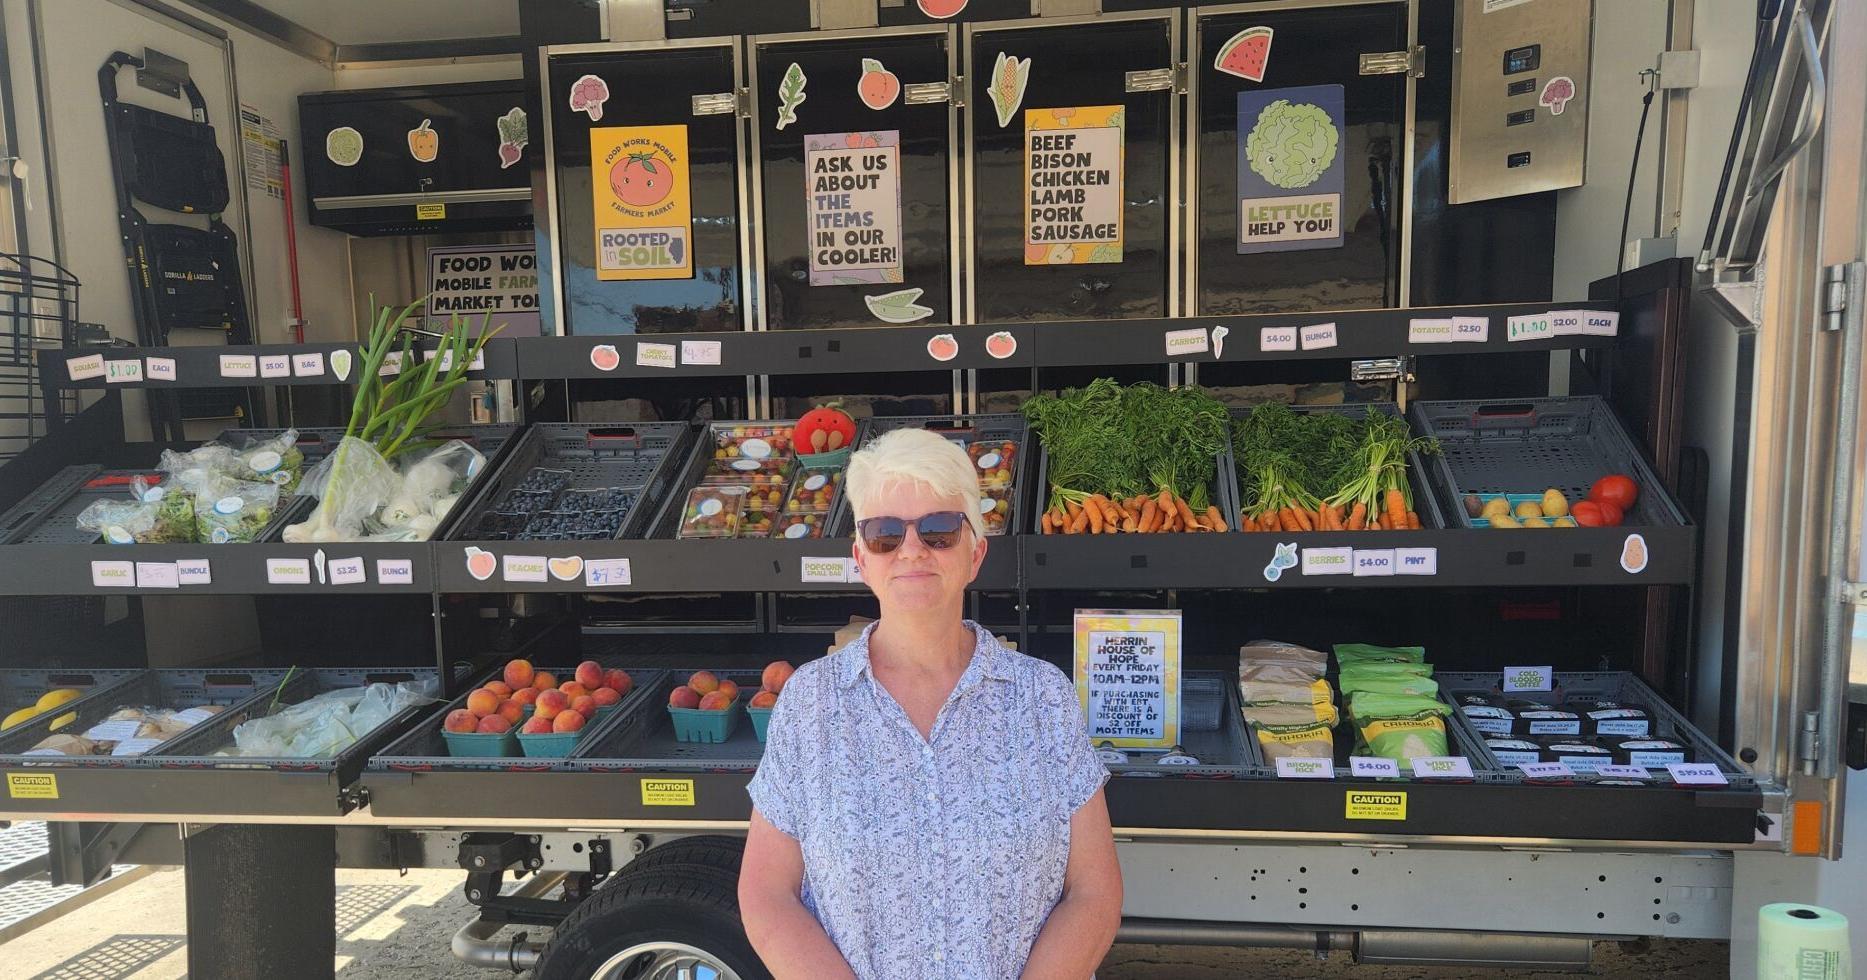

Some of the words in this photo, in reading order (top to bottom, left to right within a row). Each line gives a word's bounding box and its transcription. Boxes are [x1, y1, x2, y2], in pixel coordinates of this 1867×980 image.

[1031, 134, 1077, 152] BEEF
[605, 146, 622, 165] FOOD
[622, 138, 650, 149] WORKS
[653, 141, 677, 165] MOBILE
[814, 155, 853, 174] ASK
[862, 154, 888, 171] US
[1031, 152, 1092, 170] BISON
[814, 174, 880, 192] ABOUT
[1031, 170, 1110, 188] CHICKEN
[815, 194, 852, 211] THE
[1031, 188, 1086, 205] LAMB
[611, 201, 645, 218] FARMERS
[647, 201, 676, 218] MARKET
[1031, 206, 1084, 223] PORK
[1248, 202, 1333, 222] LETTUCE
[816, 211, 874, 229] ITEMS
[1031, 223, 1117, 241] SAUSAGE
[1248, 221, 1286, 236] HELP
[1294, 218, 1333, 233] YOU!
[603, 232, 670, 248] ROOTED
[816, 231, 835, 247] IN
[844, 229, 884, 246] OUR
[605, 250, 618, 264] in
[618, 247, 671, 266] SOIL
[817, 247, 897, 265] COOLER!
[439, 256, 492, 274] FOOD
[500, 254, 538, 272] WO
[435, 277, 492, 291] MOBILE
[434, 295, 504, 311] MARKET
[1588, 318, 1611, 328] EACH
[1305, 331, 1333, 342] BUNCH
[1412, 326, 1450, 334] POTATOES
[1169, 335, 1206, 347] CARROTS
[1266, 334, 1291, 343] $4.00
[152, 364, 170, 373] EACH
[805, 563, 843, 571] POPCORN
[1309, 555, 1346, 565] BERRIES
[1359, 558, 1389, 567] $4.00
[1404, 556, 1426, 565] PINT
[180, 567, 208, 575] BUNDLE
[382, 567, 409, 575] BUNCH
[1105, 636, 1148, 646] HERRIN
[1097, 645, 1135, 655] HOUSE
[1140, 646, 1156, 655] OF
[1108, 655, 1139, 664] HOPE
[1093, 663, 1121, 671] EVERY
[1126, 663, 1160, 672] FRIDAY
[1093, 674, 1160, 685] 10AM-12PM
[1103, 690, 1160, 699] PURCHASING
[1097, 712, 1141, 720] DISCOUNT
[1095, 727, 1122, 735] MOST
[1126, 727, 1155, 735] ITEMS
[13, 777, 51, 785] CAUTION
[647, 783, 688, 791] CAUTION
[1353, 795, 1400, 804] CAUTION
